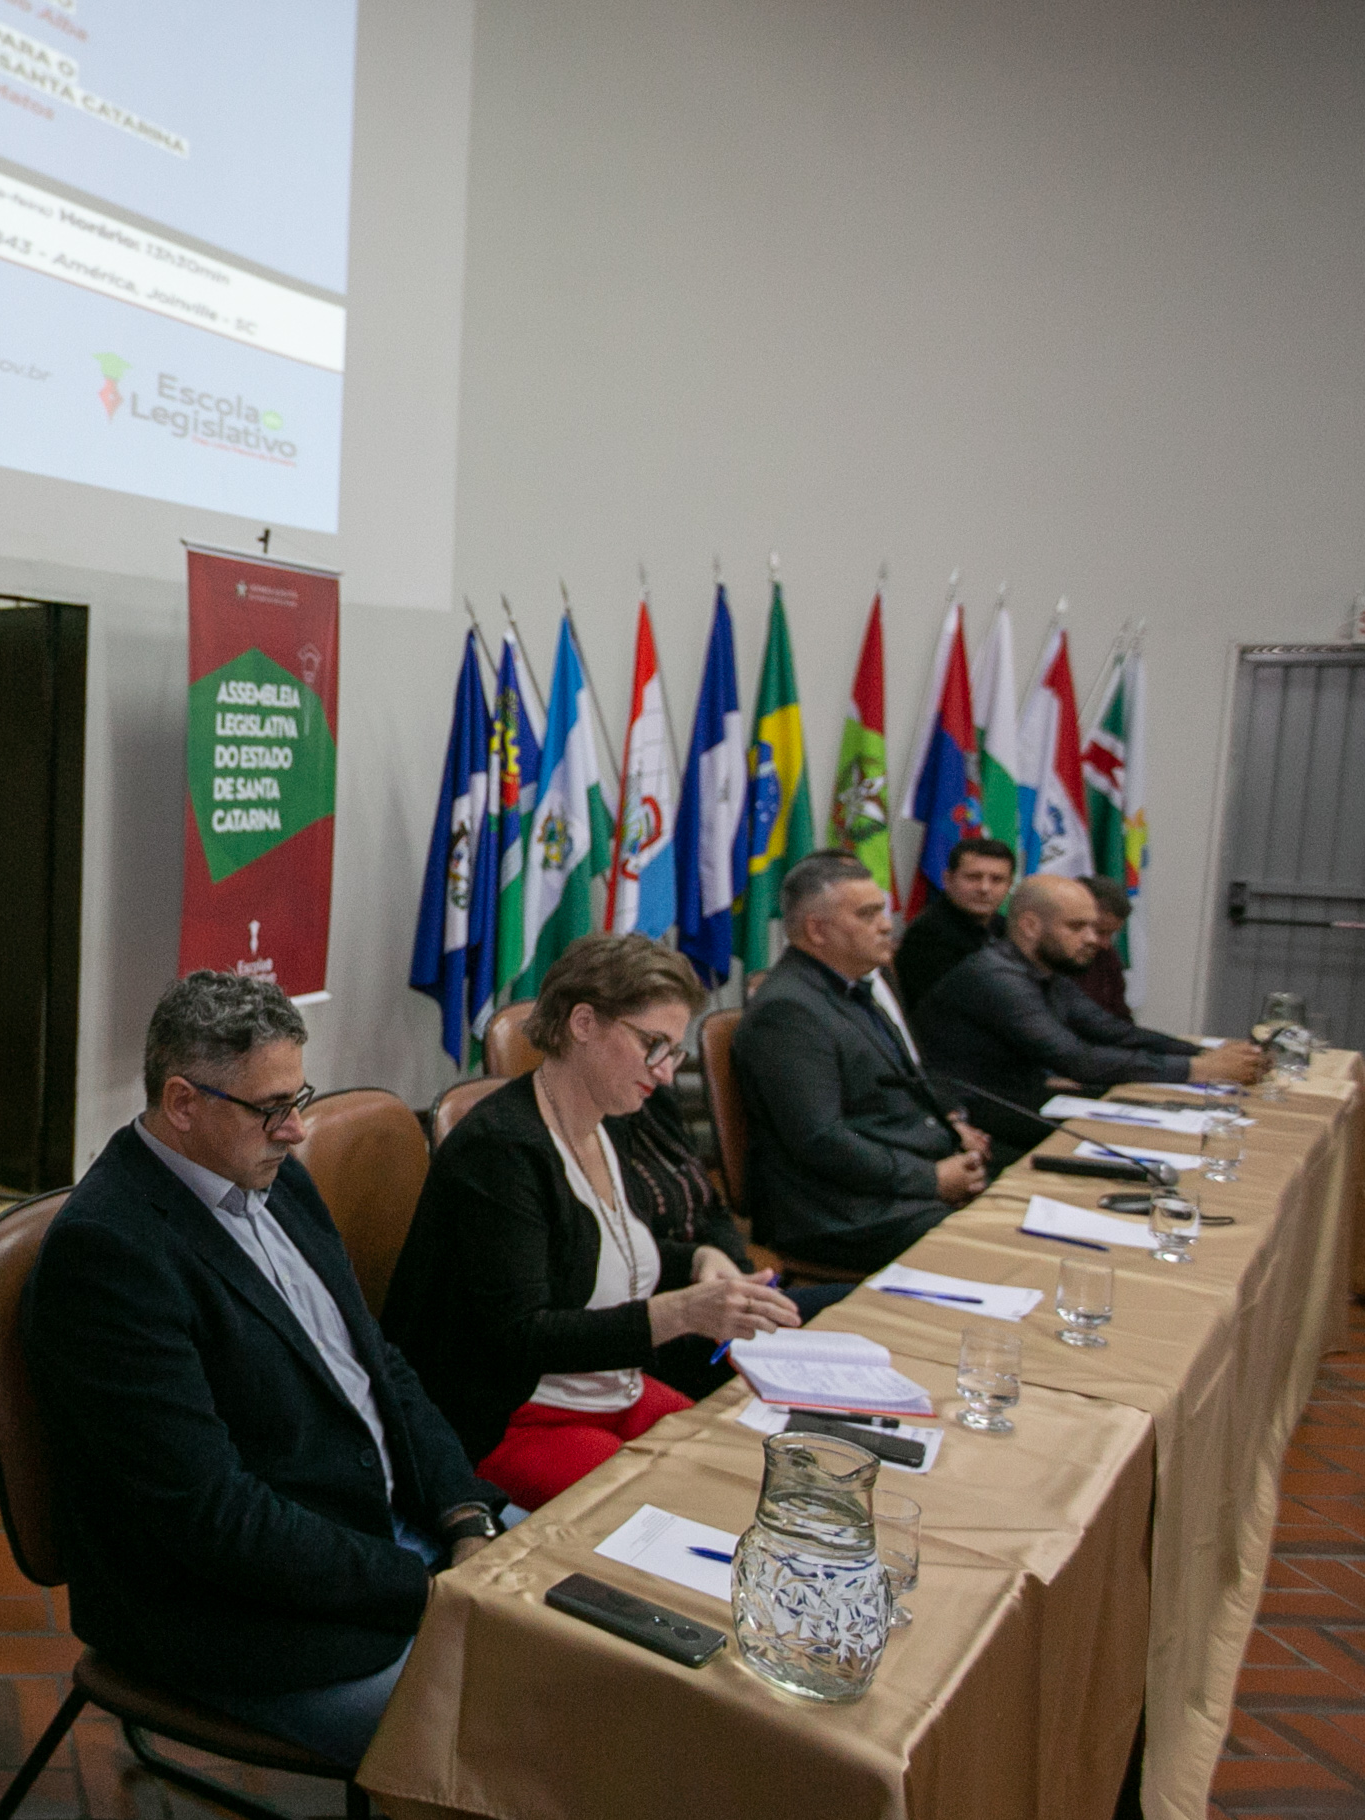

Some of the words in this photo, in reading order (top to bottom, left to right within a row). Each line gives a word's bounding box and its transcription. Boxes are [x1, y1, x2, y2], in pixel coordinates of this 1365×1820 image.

[82, 94, 187, 153] CATARINA
[53, 251, 139, 297] América,
[146, 286, 219, 323] Joinville
[234, 315, 258, 336] SC
[157, 371, 260, 424] Escola
[130, 391, 298, 458] Legislativo
[216, 680, 301, 709] ASSEMBLEIA
[215, 711, 299, 739] LEGISLATIVA
[214, 744, 238, 769] DO
[239, 745, 293, 770] ESTADO
[213, 776, 235, 800] DE
[235, 776, 281, 800] SANTA
[211, 808, 283, 833] CATARINA
